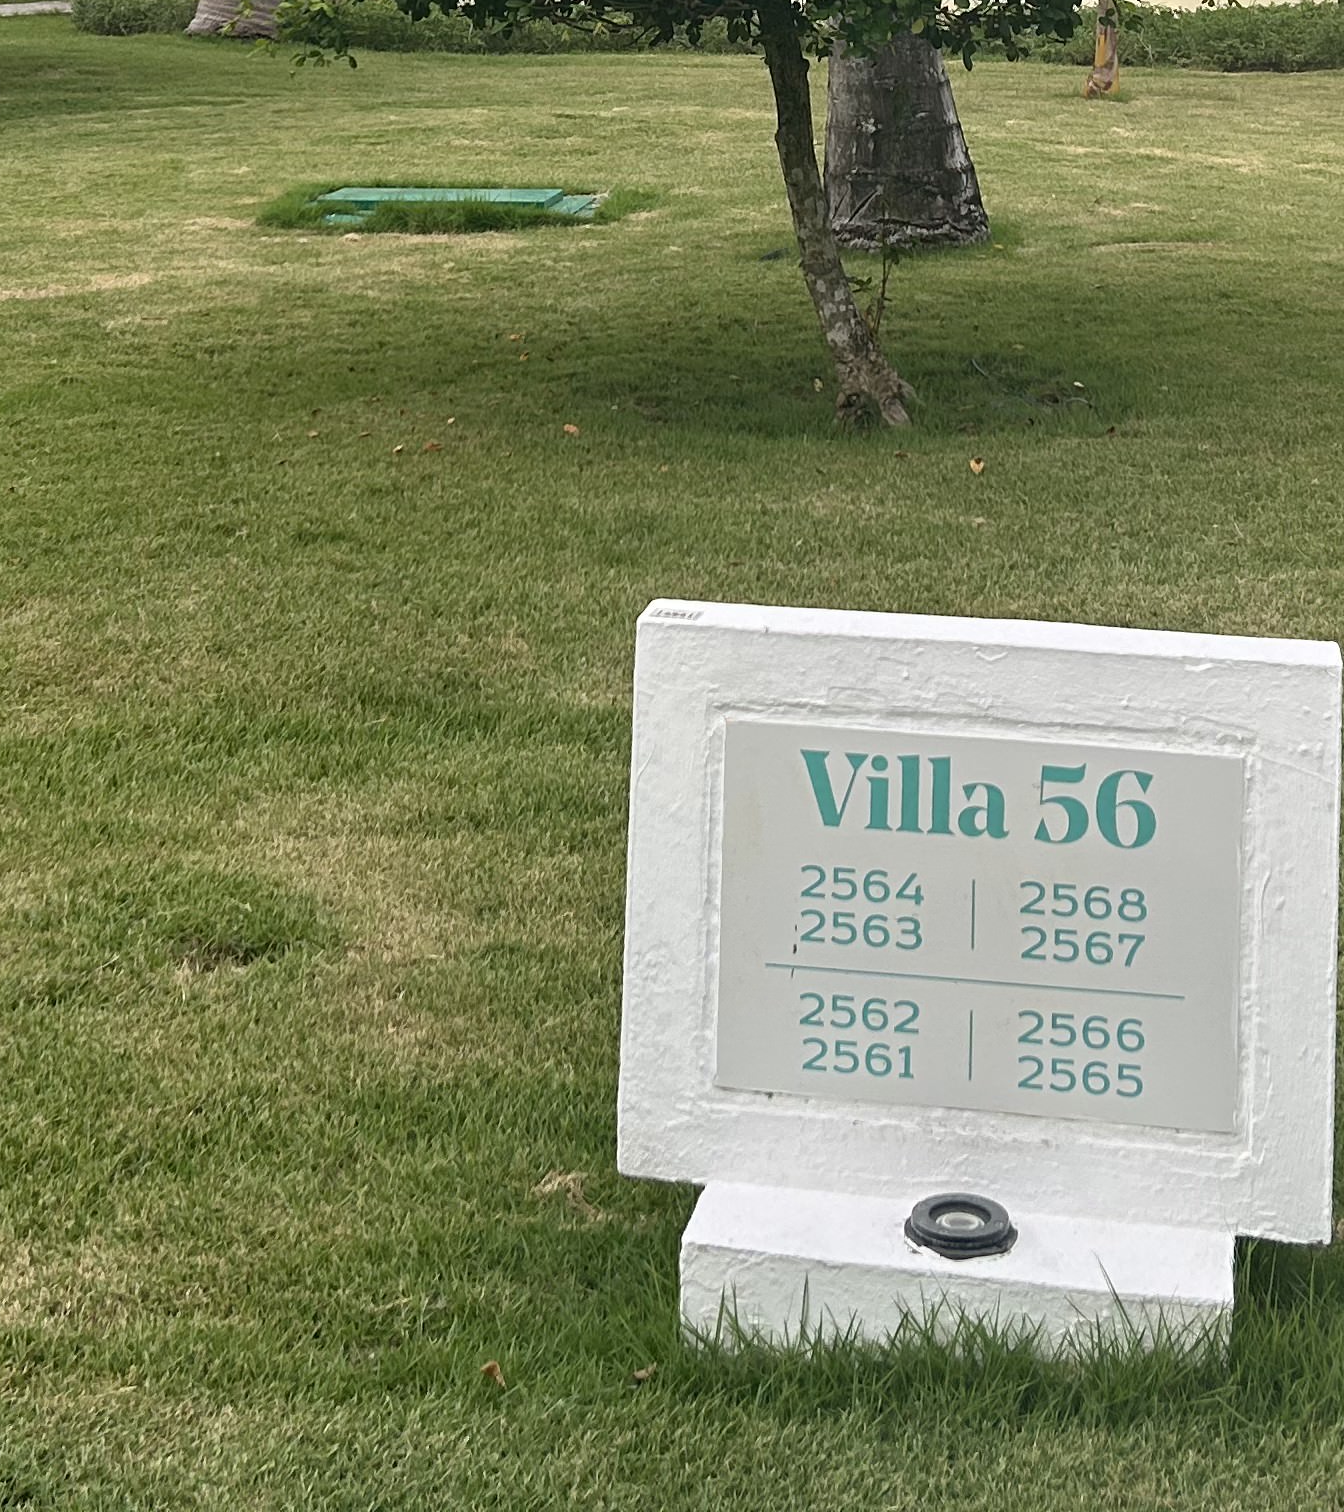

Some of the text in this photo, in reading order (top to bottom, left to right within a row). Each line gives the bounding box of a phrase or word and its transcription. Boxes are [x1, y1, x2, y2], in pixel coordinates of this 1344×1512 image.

[800, 749, 1158, 849] Villa 56
[799, 864, 925, 906] 2564
[1019, 881, 1148, 922] 2568
[799, 908, 924, 951] 2563
[1021, 926, 1146, 967] 2567
[798, 992, 920, 1035] 2562
[1017, 1010, 1146, 1053] 2566
[802, 1037, 915, 1080] 2561
[1017, 1055, 1144, 1098] 2565
